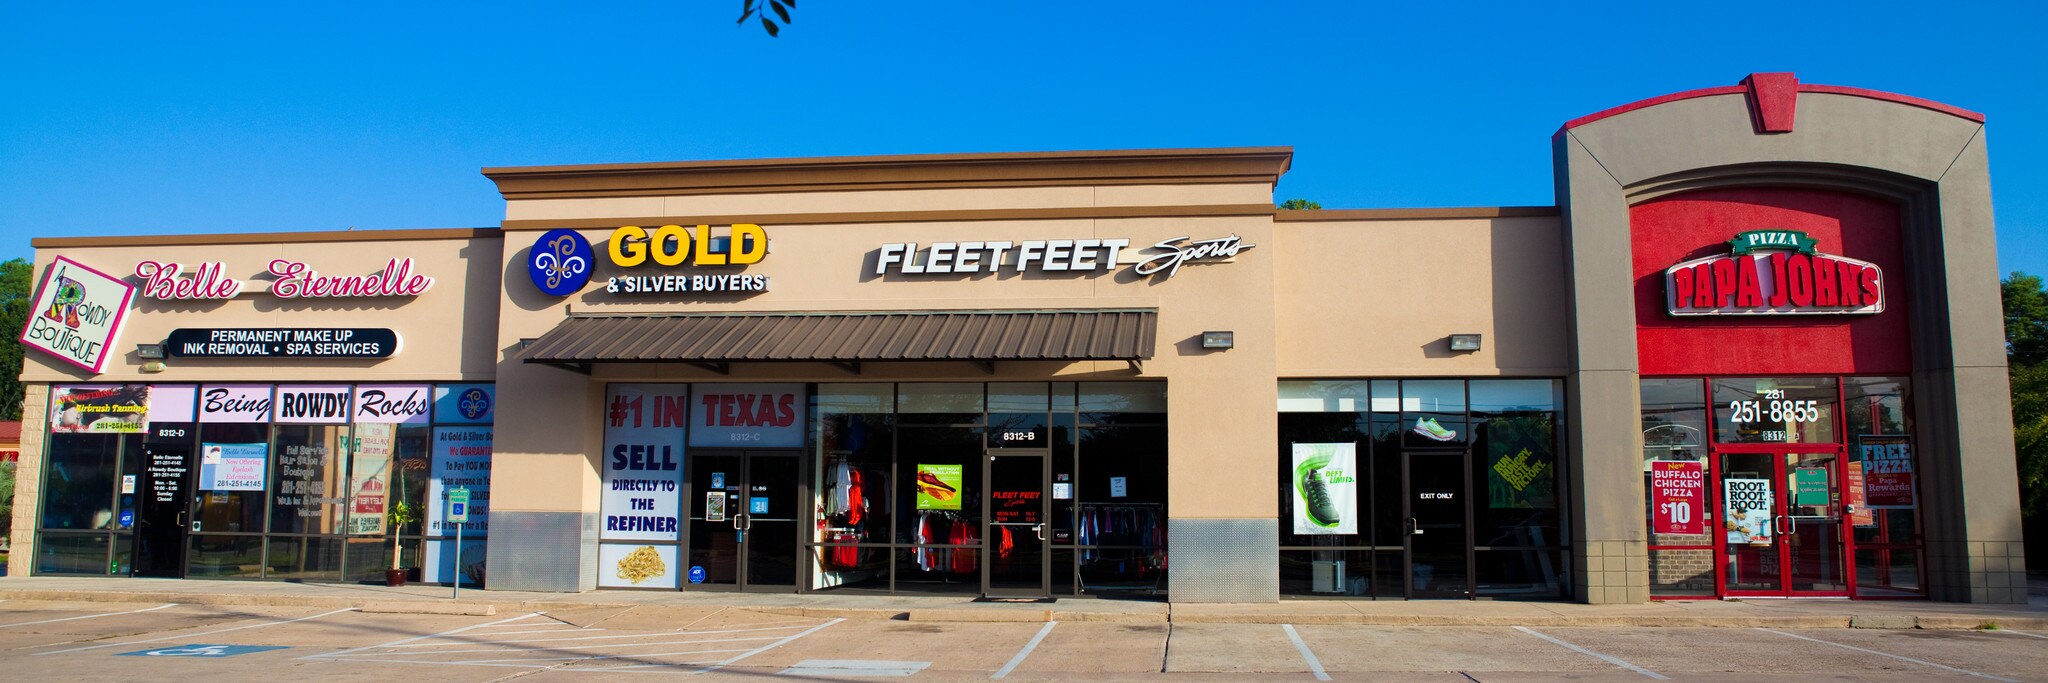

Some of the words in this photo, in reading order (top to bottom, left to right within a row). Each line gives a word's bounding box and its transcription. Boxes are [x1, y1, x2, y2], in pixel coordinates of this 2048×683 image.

[608, 223, 768, 267] GOLD
[1748, 231, 1798, 246] PIZZA
[876, 240, 1013, 275] FLEET
[1016, 238, 1130, 272] FEET
[1135, 233, 1255, 277] Sports
[54, 266, 66, 282] A
[135, 260, 241, 299] Belle
[268, 258, 433, 297] Eternelle
[1674, 254, 1763, 308] PAPA
[1768, 252, 1879, 307] JOHNS
[607, 277, 619, 293] &
[624, 275, 687, 293] SILVER
[692, 274, 765, 292] BUYERS
[211, 330, 290, 342] PERMANENT
[293, 330, 332, 342] MAKE
[335, 330, 353, 341] UP
[183, 343, 205, 354] INK
[208, 343, 269, 354] REMOVAL
[286, 343, 312, 354] SPA
[314, 343, 379, 354] SERVICES
[1764, 389, 1784, 399] 281
[75, 404, 111, 413] Airbrush
[112, 404, 147, 414] Tanning
[204, 388, 271, 421] Being
[282, 392, 349, 418] ROWDY
[358, 389, 428, 417] Rocks
[702, 393, 795, 427] TEXAS
[609, 394, 643, 429] #1
[653, 395, 686, 428] IN
[1730, 400, 1819, 422] 251-8855
[159, 429, 185, 437] 8312-D
[440, 432, 448, 441] At
[448, 432, 462, 441] Gold
[468, 431, 484, 441] Silver
[730, 432, 760, 441] 8312-C
[1003, 432, 1035, 440] 8312-B
[1763, 431, 1785, 440] 8312
[612, 444, 677, 471] SELL
[1861, 444, 1911, 460] FREE
[453, 462, 465, 473] Pay
[465, 462, 478, 471] YOU
[1493, 454, 1512, 474] RUN
[1500, 447, 1532, 482] HUNGRY.
[1667, 462, 1685, 470] New
[1861, 460, 1912, 475] PIZZA
[1510, 462, 1531, 487] TASTE
[1513, 459, 1546, 491] VICTORY.
[1654, 470, 1700, 479] BUFFALO
[612, 479, 659, 492] DIRECTLY
[661, 479, 675, 491] TO
[1654, 479, 1701, 488] CHICKEN
[1729, 482, 1766, 491] ROOT.
[1868, 483, 1910, 492] Rewards
[1663, 488, 1693, 497] PIZZA
[1729, 491, 1767, 500] ROOT.
[630, 498, 655, 510] THE
[1730, 500, 1767, 510] ROOT.
[1661, 502, 1690, 523] $10
[607, 516, 677, 532] REFINER
[1760, 564, 1800, 575] PIZA
